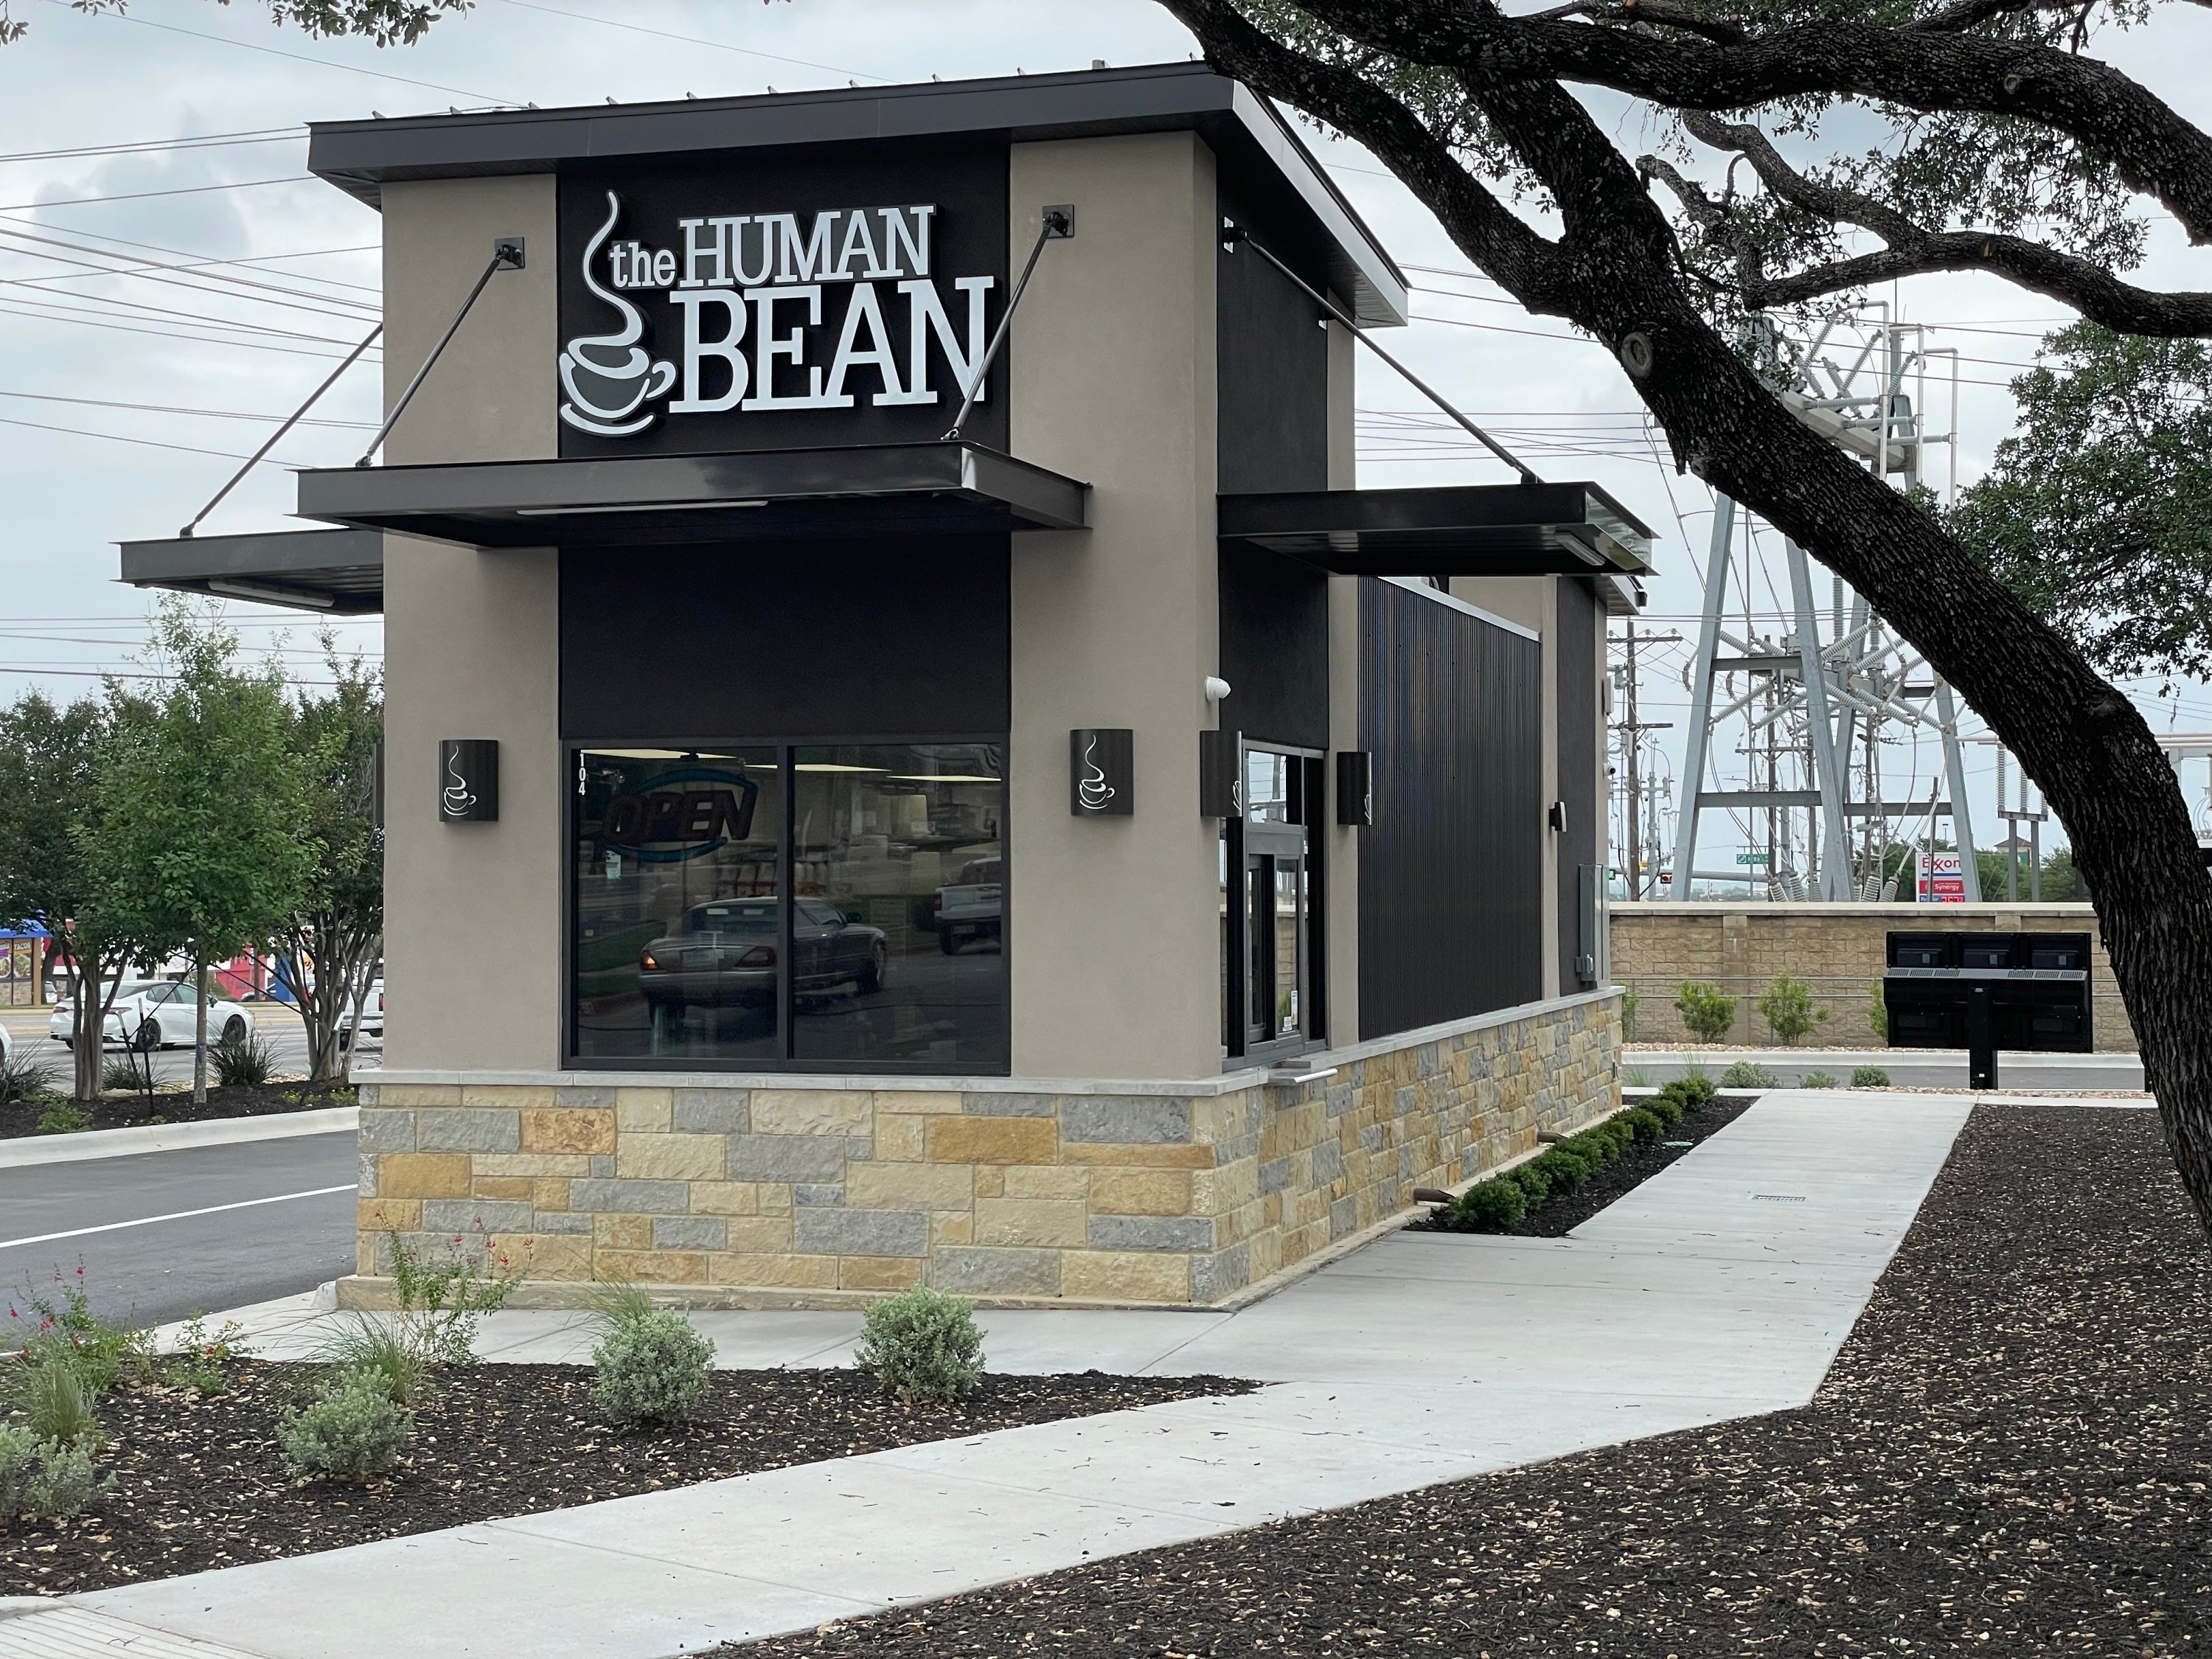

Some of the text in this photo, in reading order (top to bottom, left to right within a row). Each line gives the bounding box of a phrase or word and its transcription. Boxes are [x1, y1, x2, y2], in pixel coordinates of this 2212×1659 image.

[608, 205, 935, 288] the HUMAN
[669, 275, 995, 414] BEAN
[578, 753, 586, 796] 104
[602, 787, 759, 846] OPEN
[1922, 858, 1961, 872] Exxon
[1935, 883, 1960, 891] Synergy
[13, 942, 31, 950] TACOS
